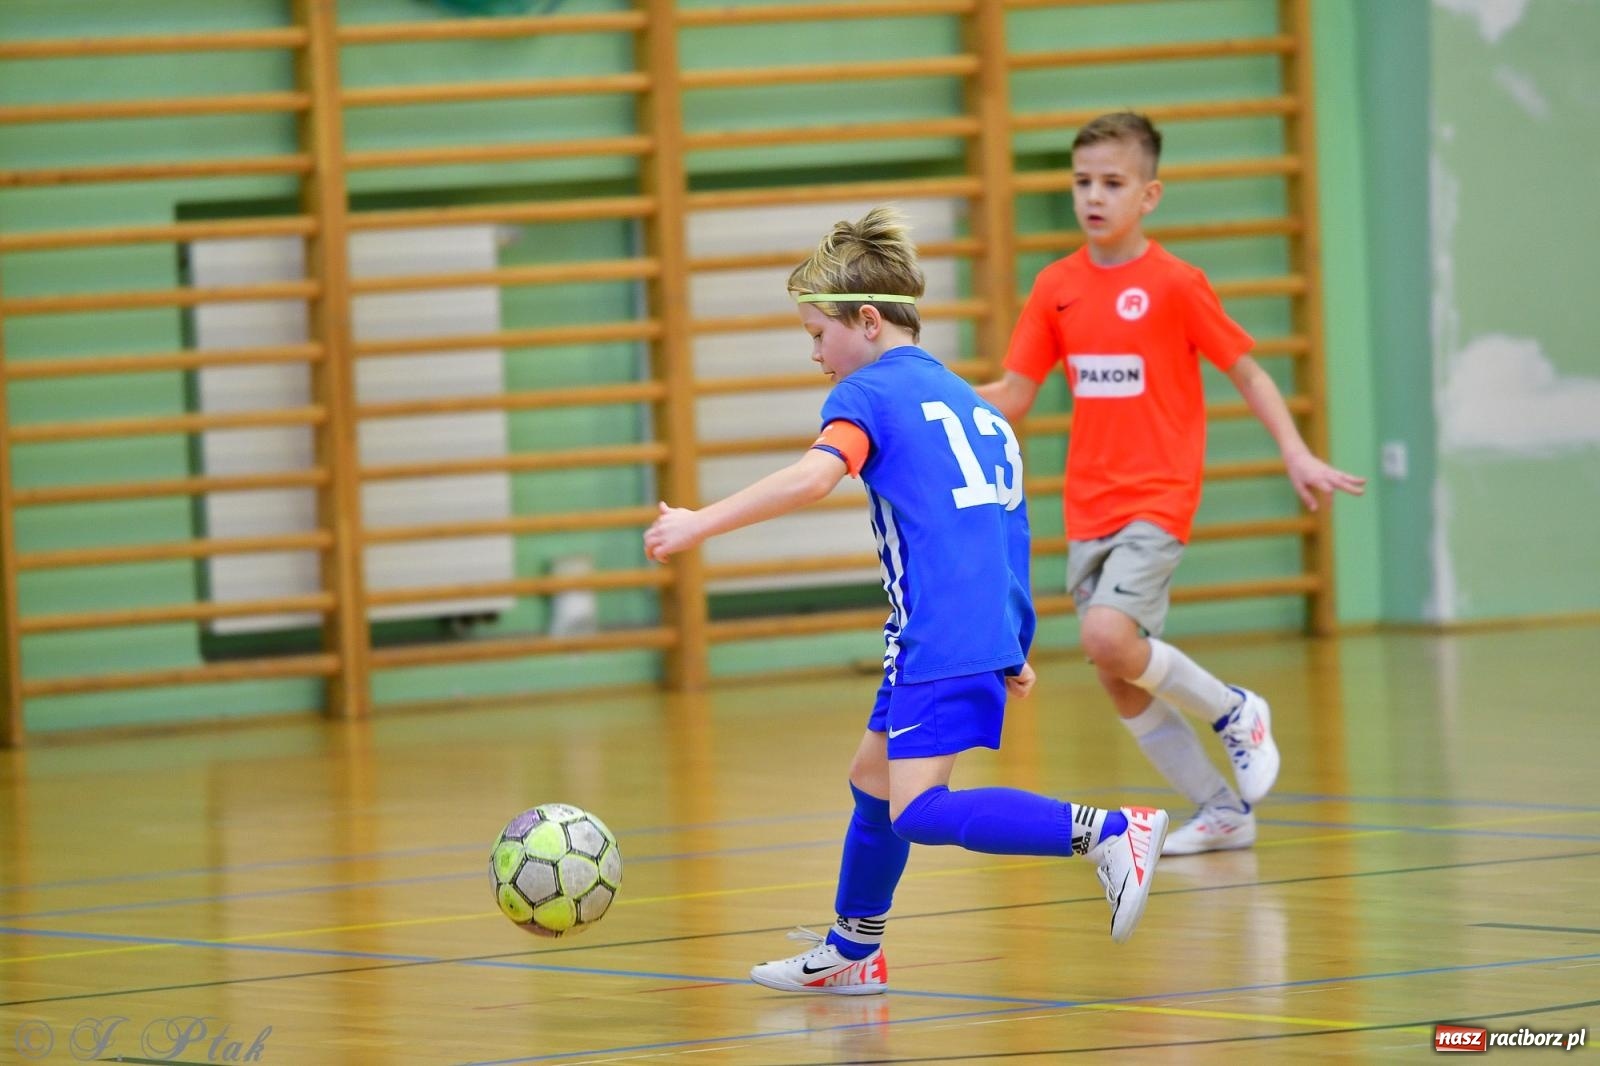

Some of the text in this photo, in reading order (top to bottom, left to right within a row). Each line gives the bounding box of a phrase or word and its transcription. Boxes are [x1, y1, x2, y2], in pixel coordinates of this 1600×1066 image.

[1080, 368, 1140, 383] PAKON
[920, 400, 1024, 512] 13
[824, 957, 882, 987] NIKE
